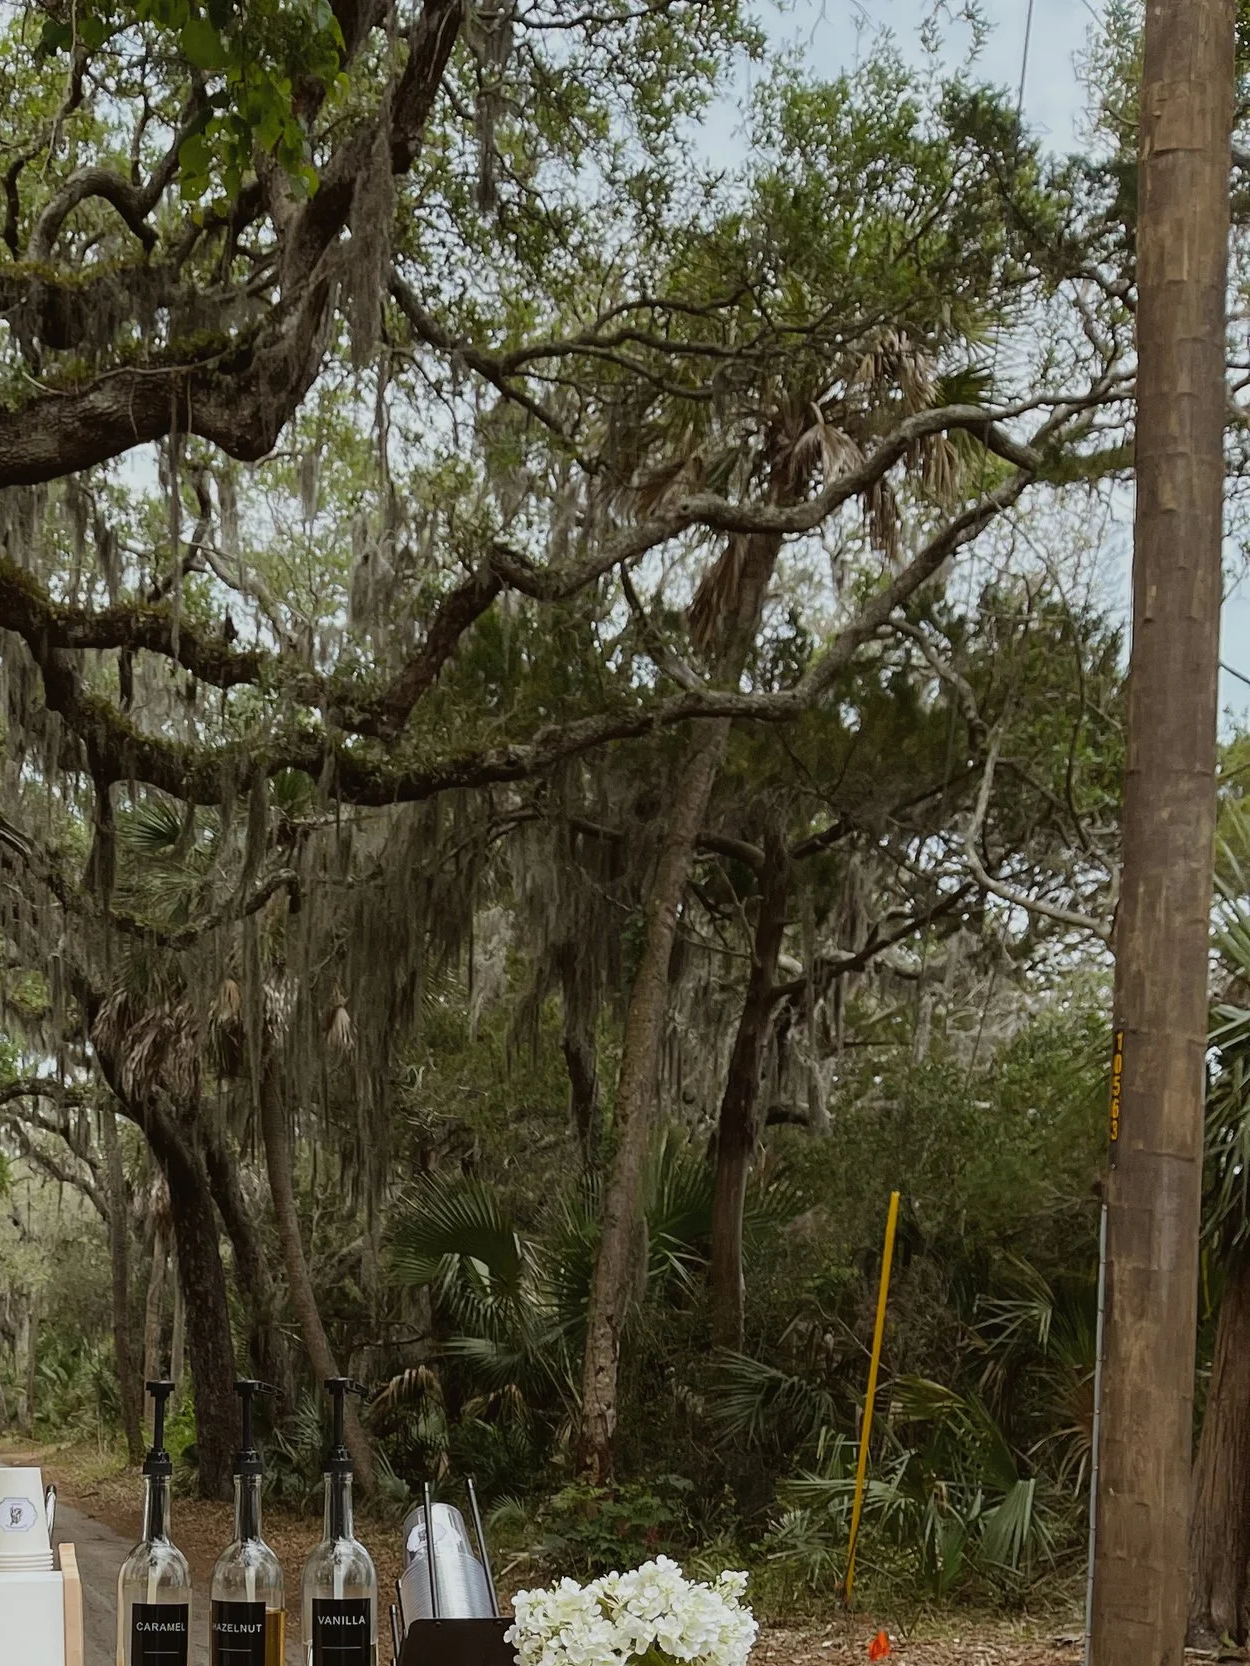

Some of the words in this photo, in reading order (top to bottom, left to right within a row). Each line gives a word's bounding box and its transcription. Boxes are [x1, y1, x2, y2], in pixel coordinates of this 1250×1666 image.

[317, 1615, 366, 1625] VANILLA
[136, 1621, 186, 1632] CARAMEL
[213, 1623, 263, 1633] HAZELNUT
